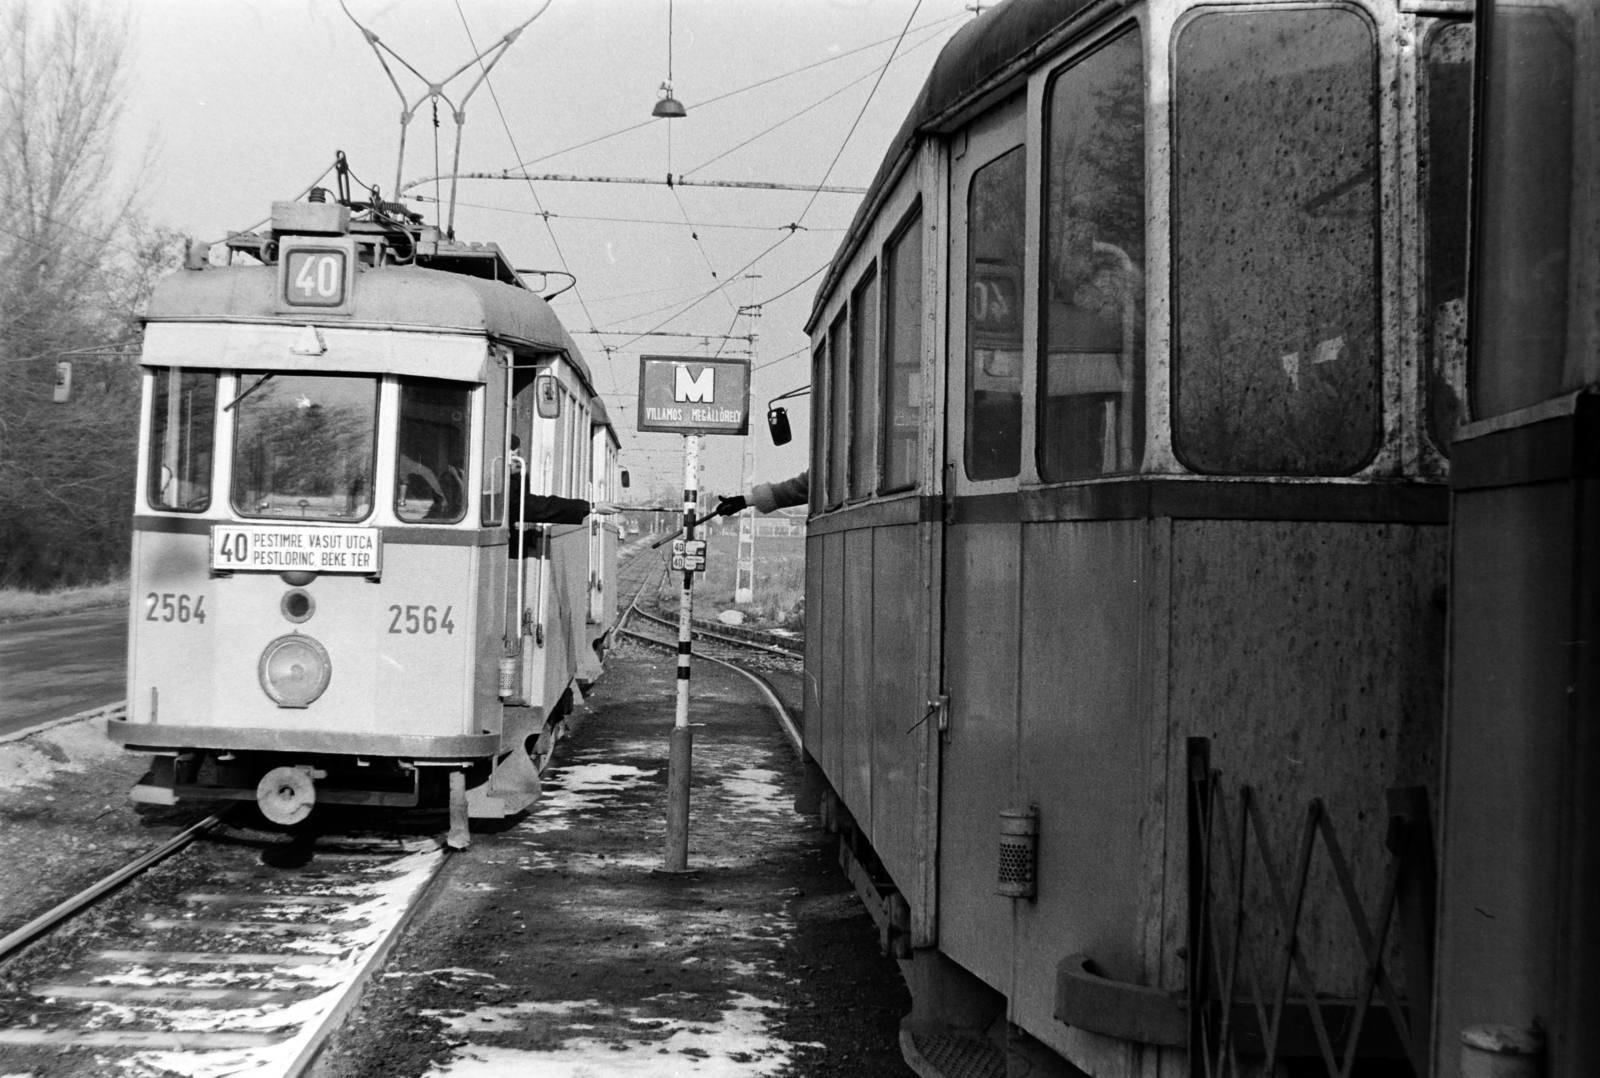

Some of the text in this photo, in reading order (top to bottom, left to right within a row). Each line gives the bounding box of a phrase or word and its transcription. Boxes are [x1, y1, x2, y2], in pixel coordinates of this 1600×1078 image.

[295, 256, 338, 297] 40
[675, 366, 715, 403] M
[646, 407, 683, 421] VILLAMOS
[220, 533, 248, 562] 40
[346, 535, 373, 550] UTCA
[675, 543, 684, 552] 40
[321, 549, 347, 566] BÉKE
[351, 550, 370, 567] TÉR
[674, 558, 683, 567] 40
[146, 592, 206, 624] 2564
[388, 604, 454, 635] 2564
